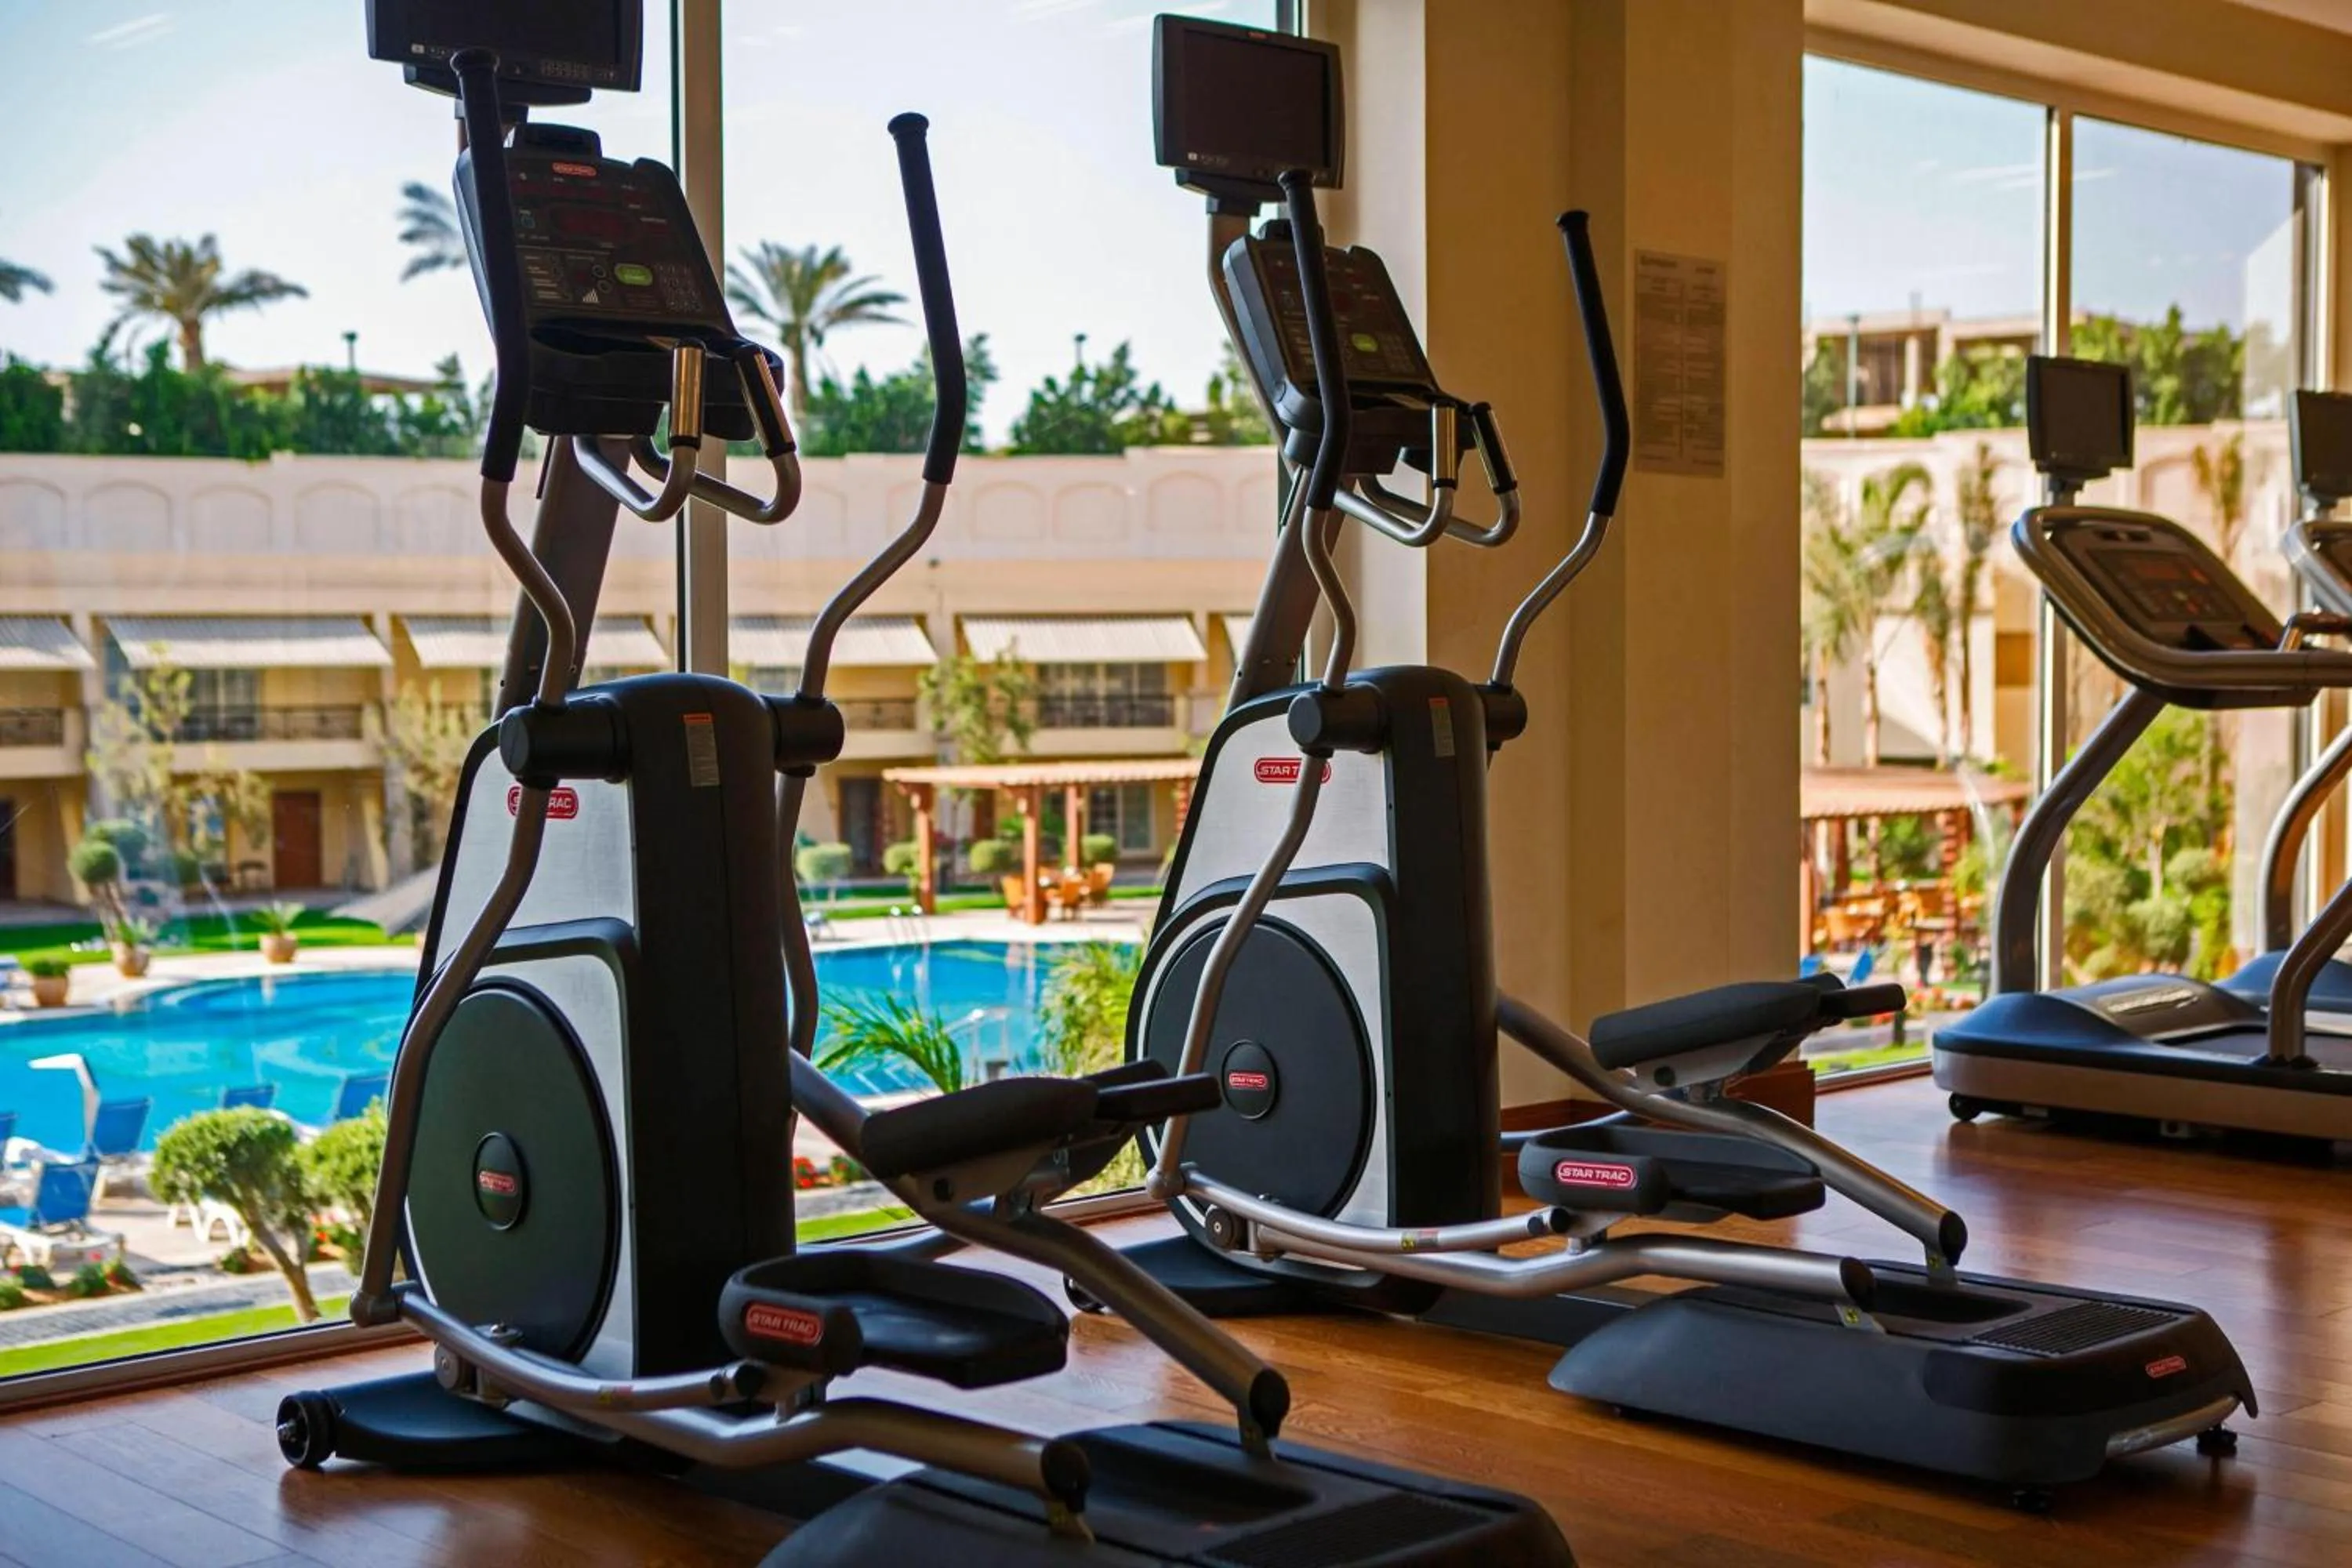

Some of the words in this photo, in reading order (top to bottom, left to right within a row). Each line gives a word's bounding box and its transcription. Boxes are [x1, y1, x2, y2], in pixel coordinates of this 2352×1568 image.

[1258, 765, 1290, 775] STAR
[548, 796, 572, 808] RAC
[1560, 1167, 1593, 1178] STAR
[1595, 1170, 1628, 1181] TRAC
[752, 1312, 782, 1329] STAR
[782, 1318, 814, 1335] TRAC
